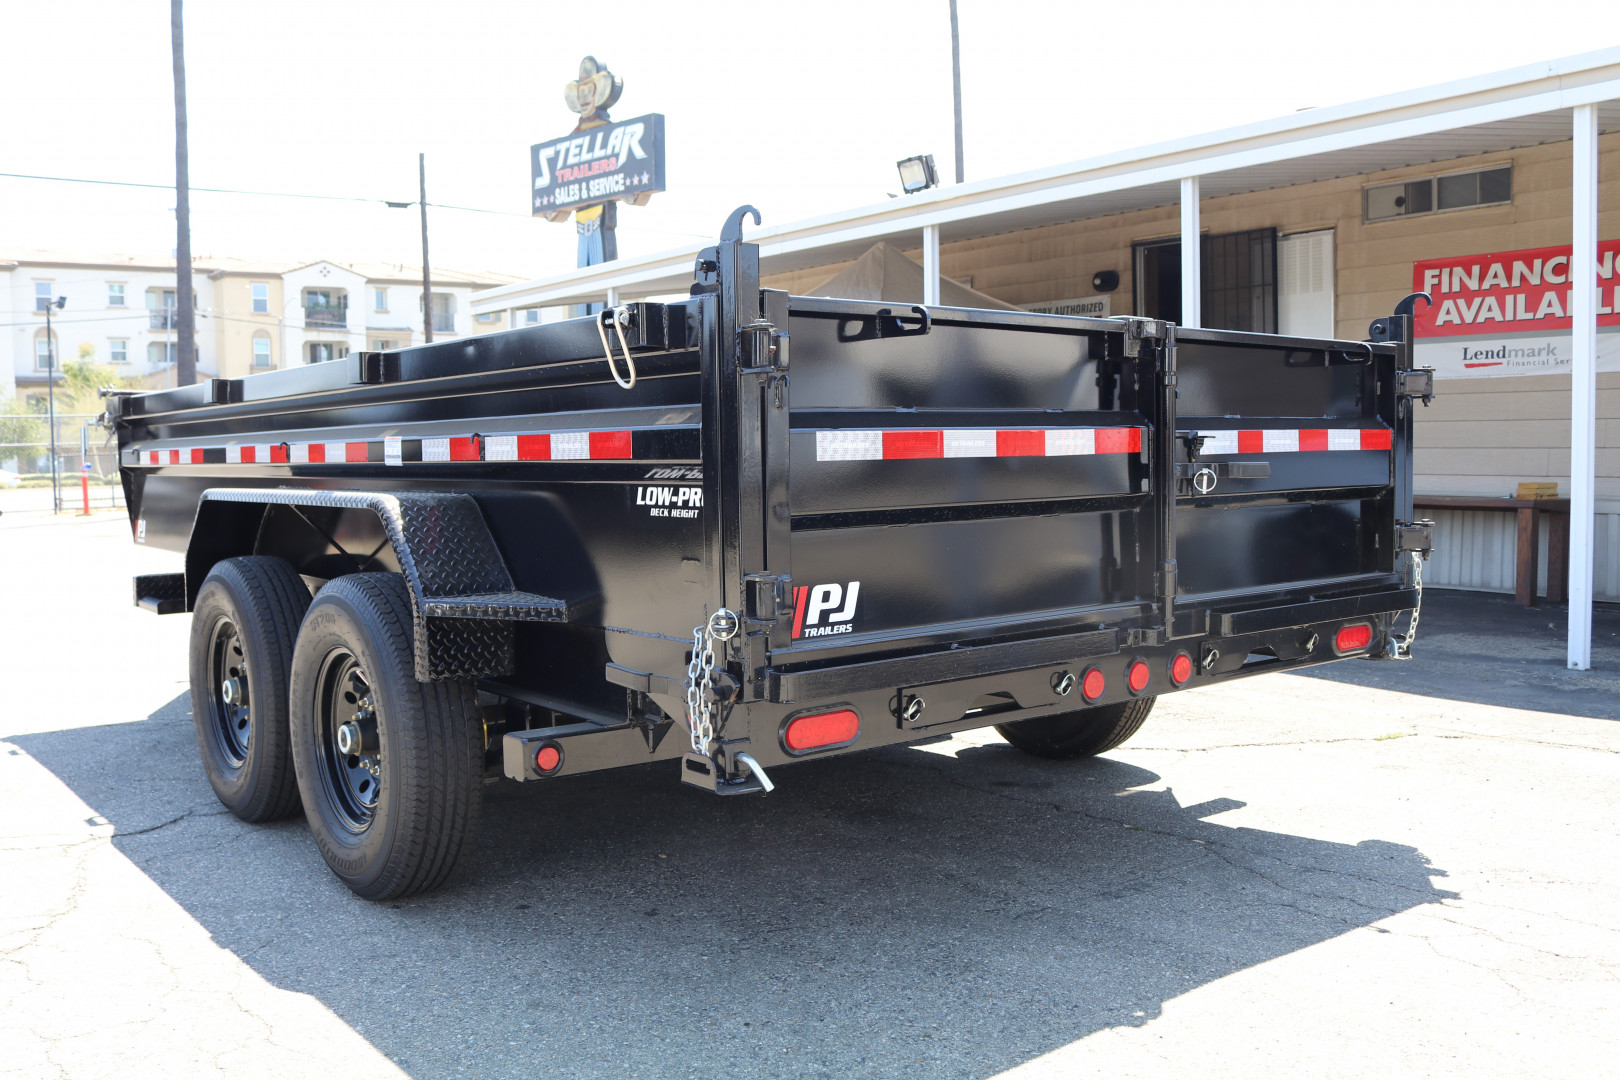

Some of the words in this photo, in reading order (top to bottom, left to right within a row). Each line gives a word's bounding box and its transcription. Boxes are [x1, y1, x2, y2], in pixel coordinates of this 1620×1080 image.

[534, 122, 648, 189] STELLAR
[555, 157, 618, 183] TRAILERS
[555, 183, 580, 205] SALES
[581, 181, 588, 198] &
[588, 173, 625, 197] SERVICE
[1054, 302, 1104, 315] AUTHORIZED
[1462, 343, 1557, 361] Lendmark
[1506, 359, 1549, 367] Financial
[636, 487, 703, 507] LOW-PR
[650, 507, 669, 517] DECK
[671, 509, 699, 518] HEIGHT
[806, 581, 860, 625] PJ
[804, 624, 853, 637] TRAILERS
